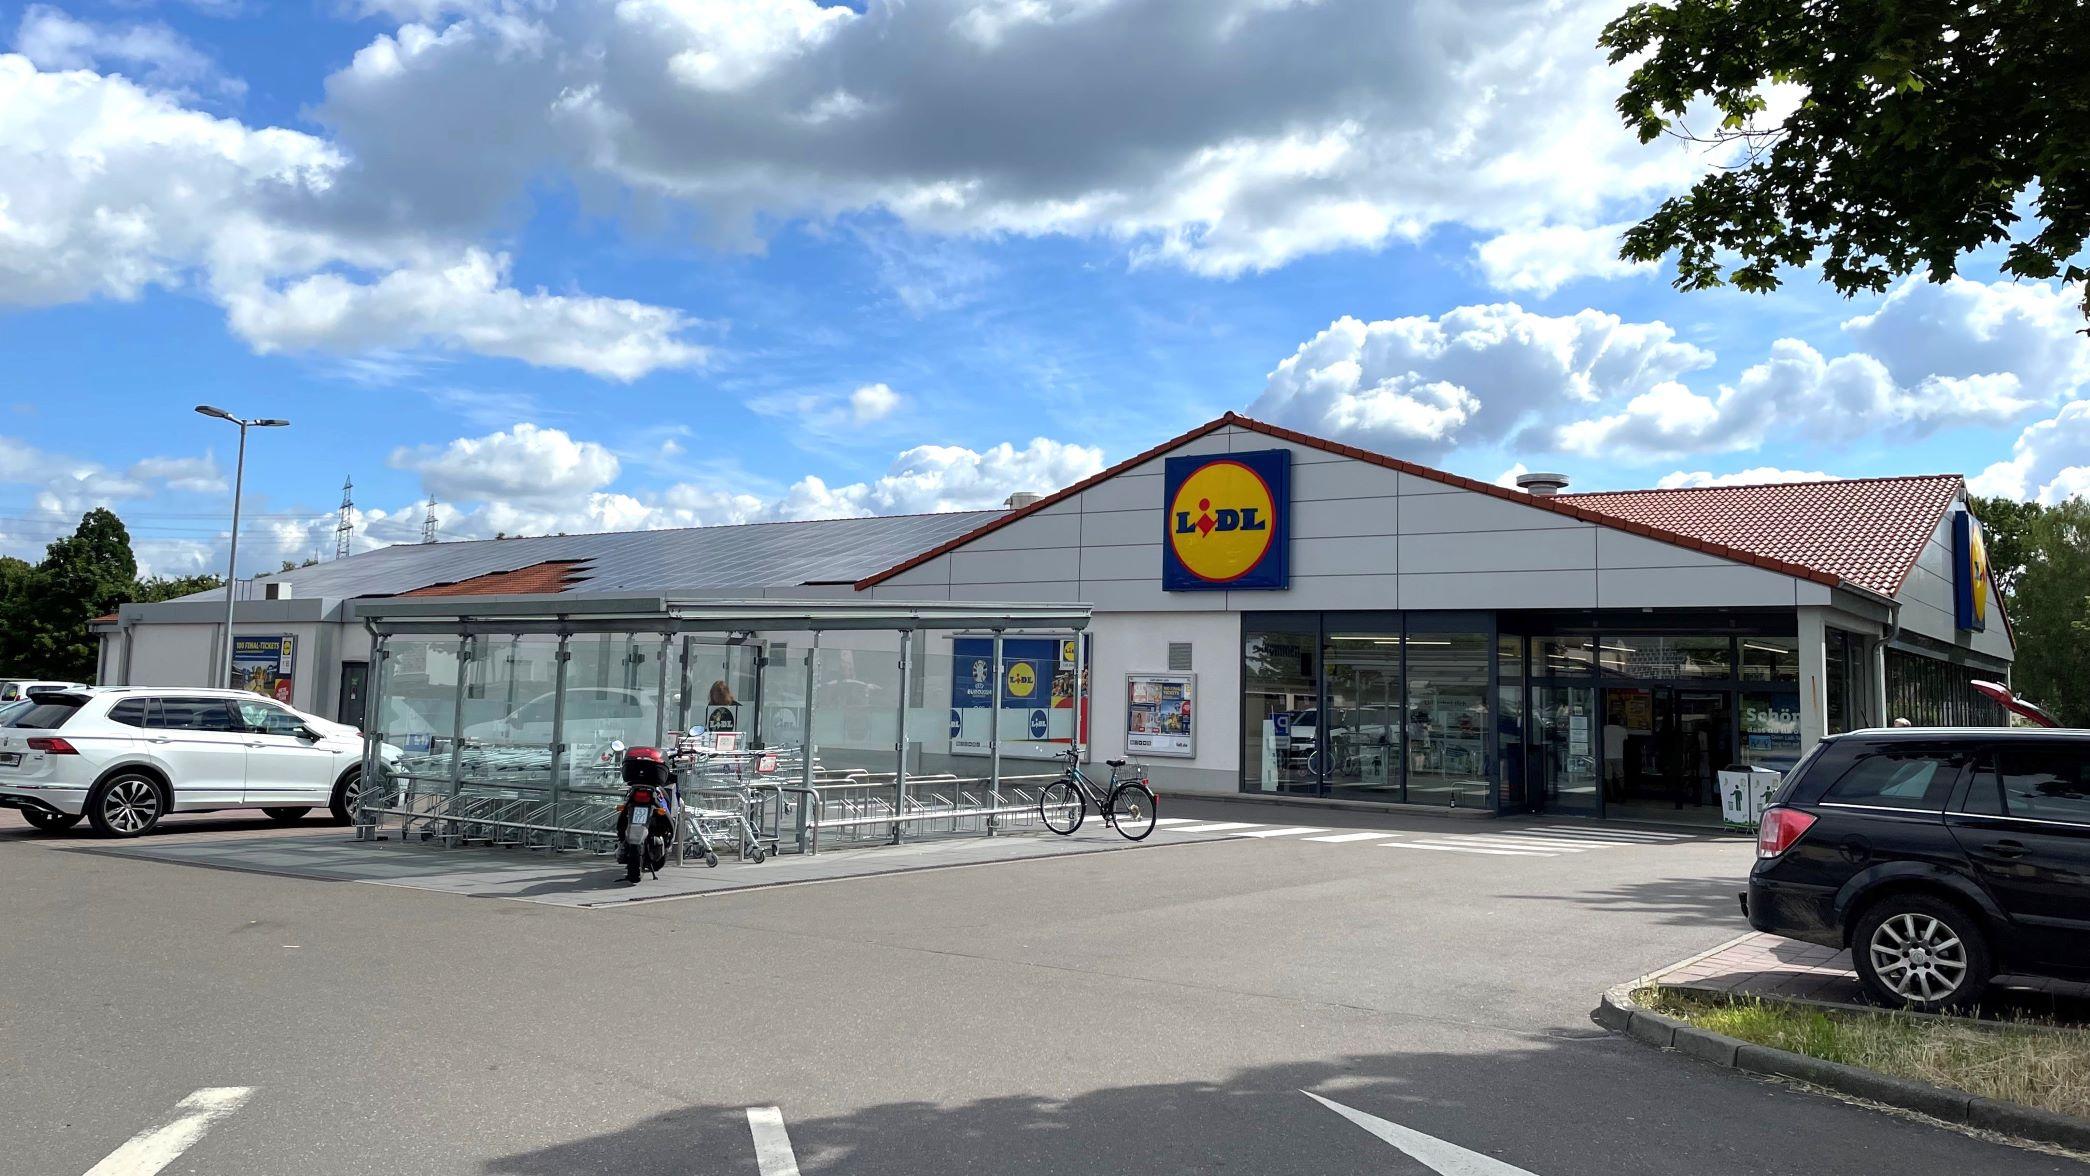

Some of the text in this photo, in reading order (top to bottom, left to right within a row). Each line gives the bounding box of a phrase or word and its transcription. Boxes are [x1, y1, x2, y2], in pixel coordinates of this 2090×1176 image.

[1176, 498, 1266, 538] LIDL
[1010, 673, 1033, 684] LIDL
[1031, 718, 1047, 728] LIDL
